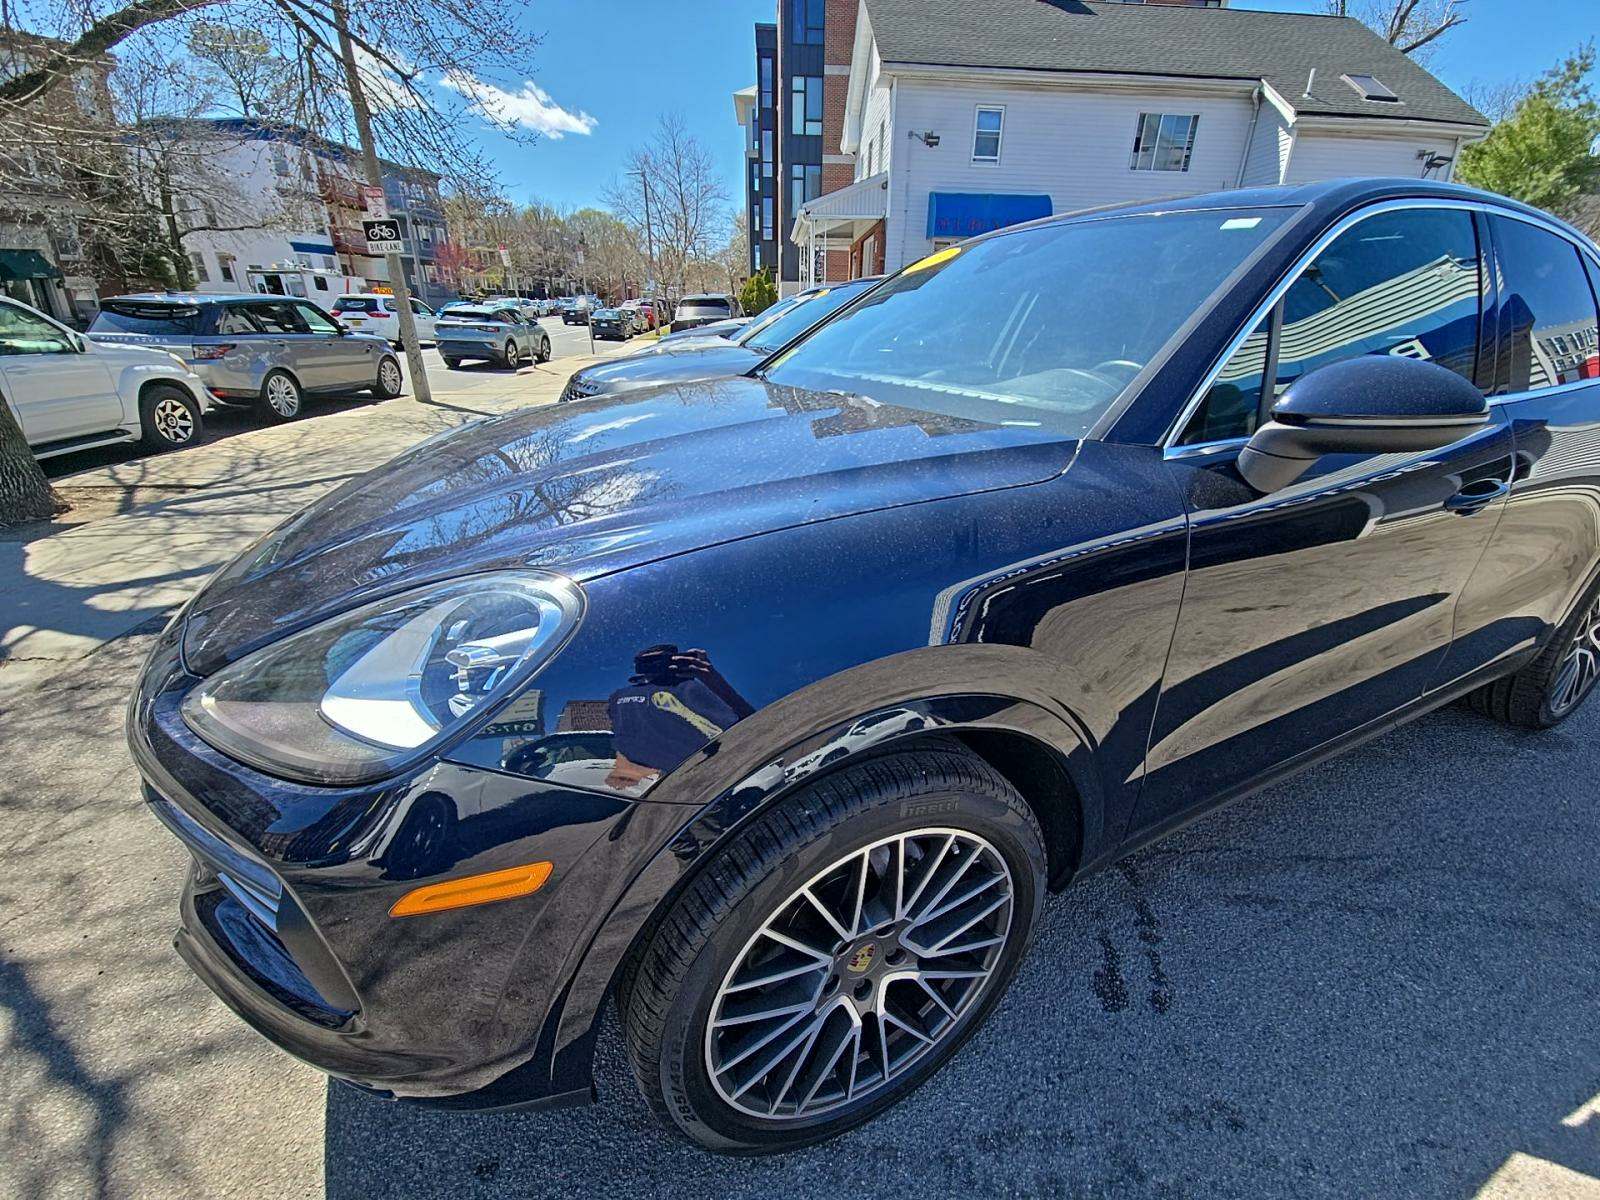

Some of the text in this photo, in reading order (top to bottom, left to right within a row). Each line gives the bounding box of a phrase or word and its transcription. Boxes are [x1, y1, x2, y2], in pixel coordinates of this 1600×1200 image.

[370, 242, 402, 252] BIKE LANE
[899, 795, 960, 817] PIRELLI
[669, 1062, 699, 1123] 285/40
